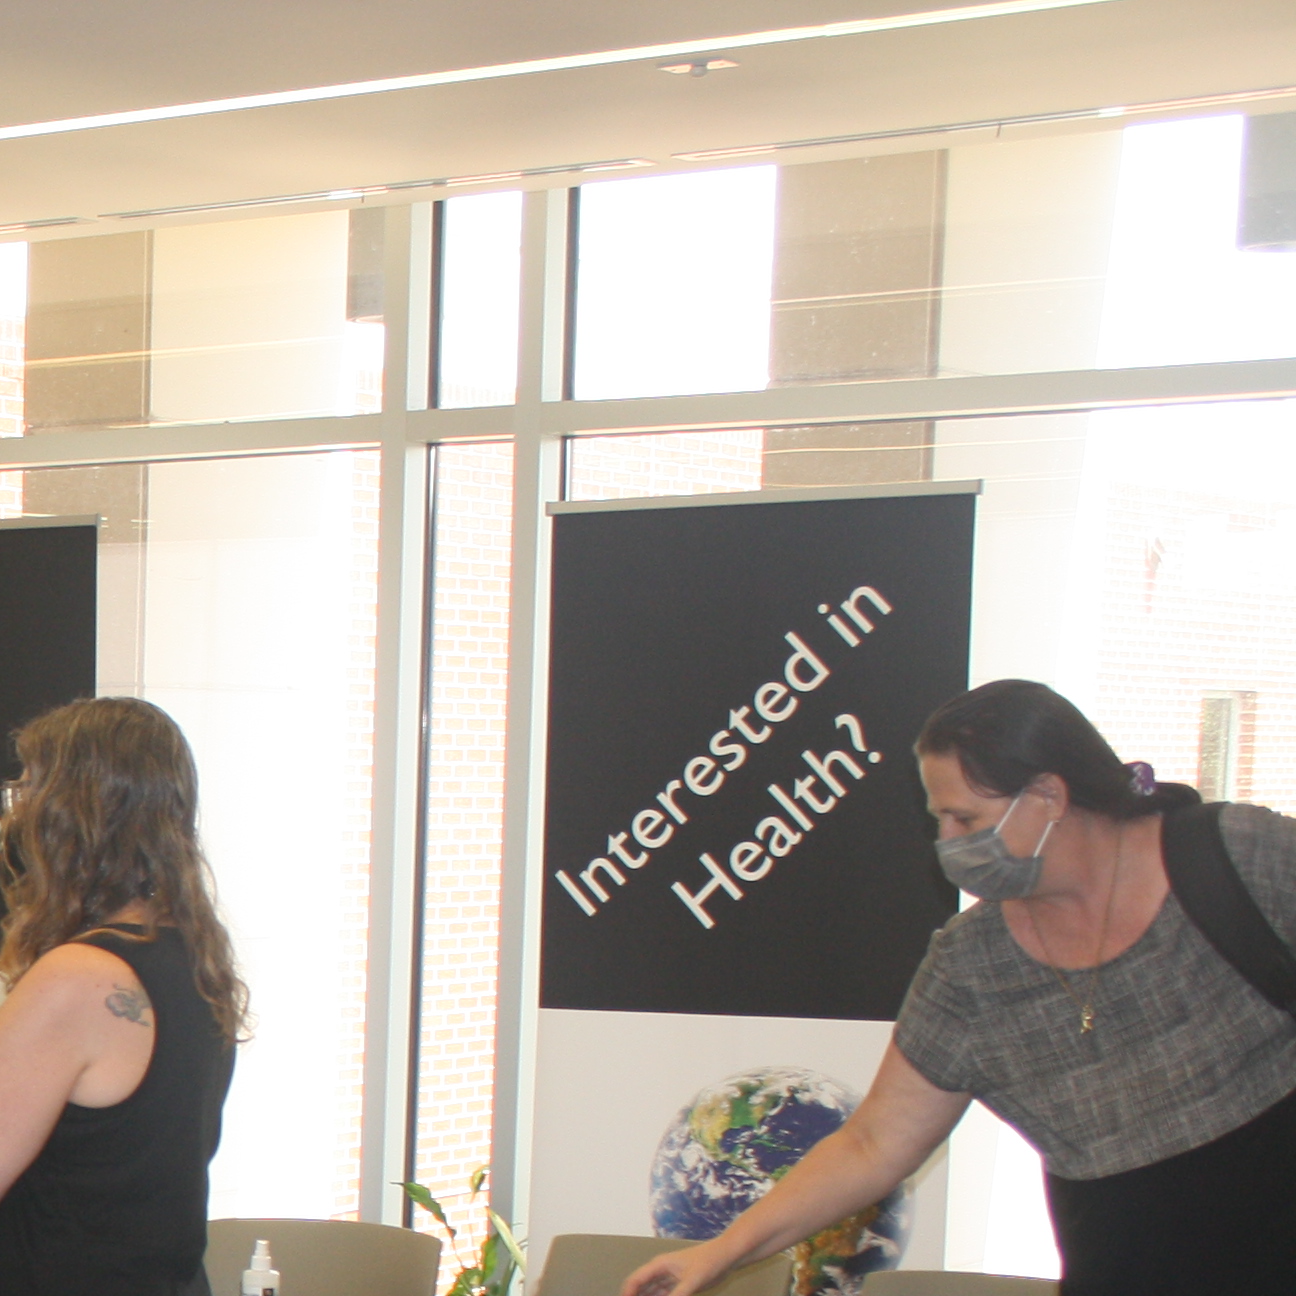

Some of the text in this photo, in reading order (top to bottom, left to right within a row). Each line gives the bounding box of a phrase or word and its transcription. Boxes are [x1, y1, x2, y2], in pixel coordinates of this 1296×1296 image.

[555, 586, 893, 917] Interested in
[671, 713, 882, 929] Health?
